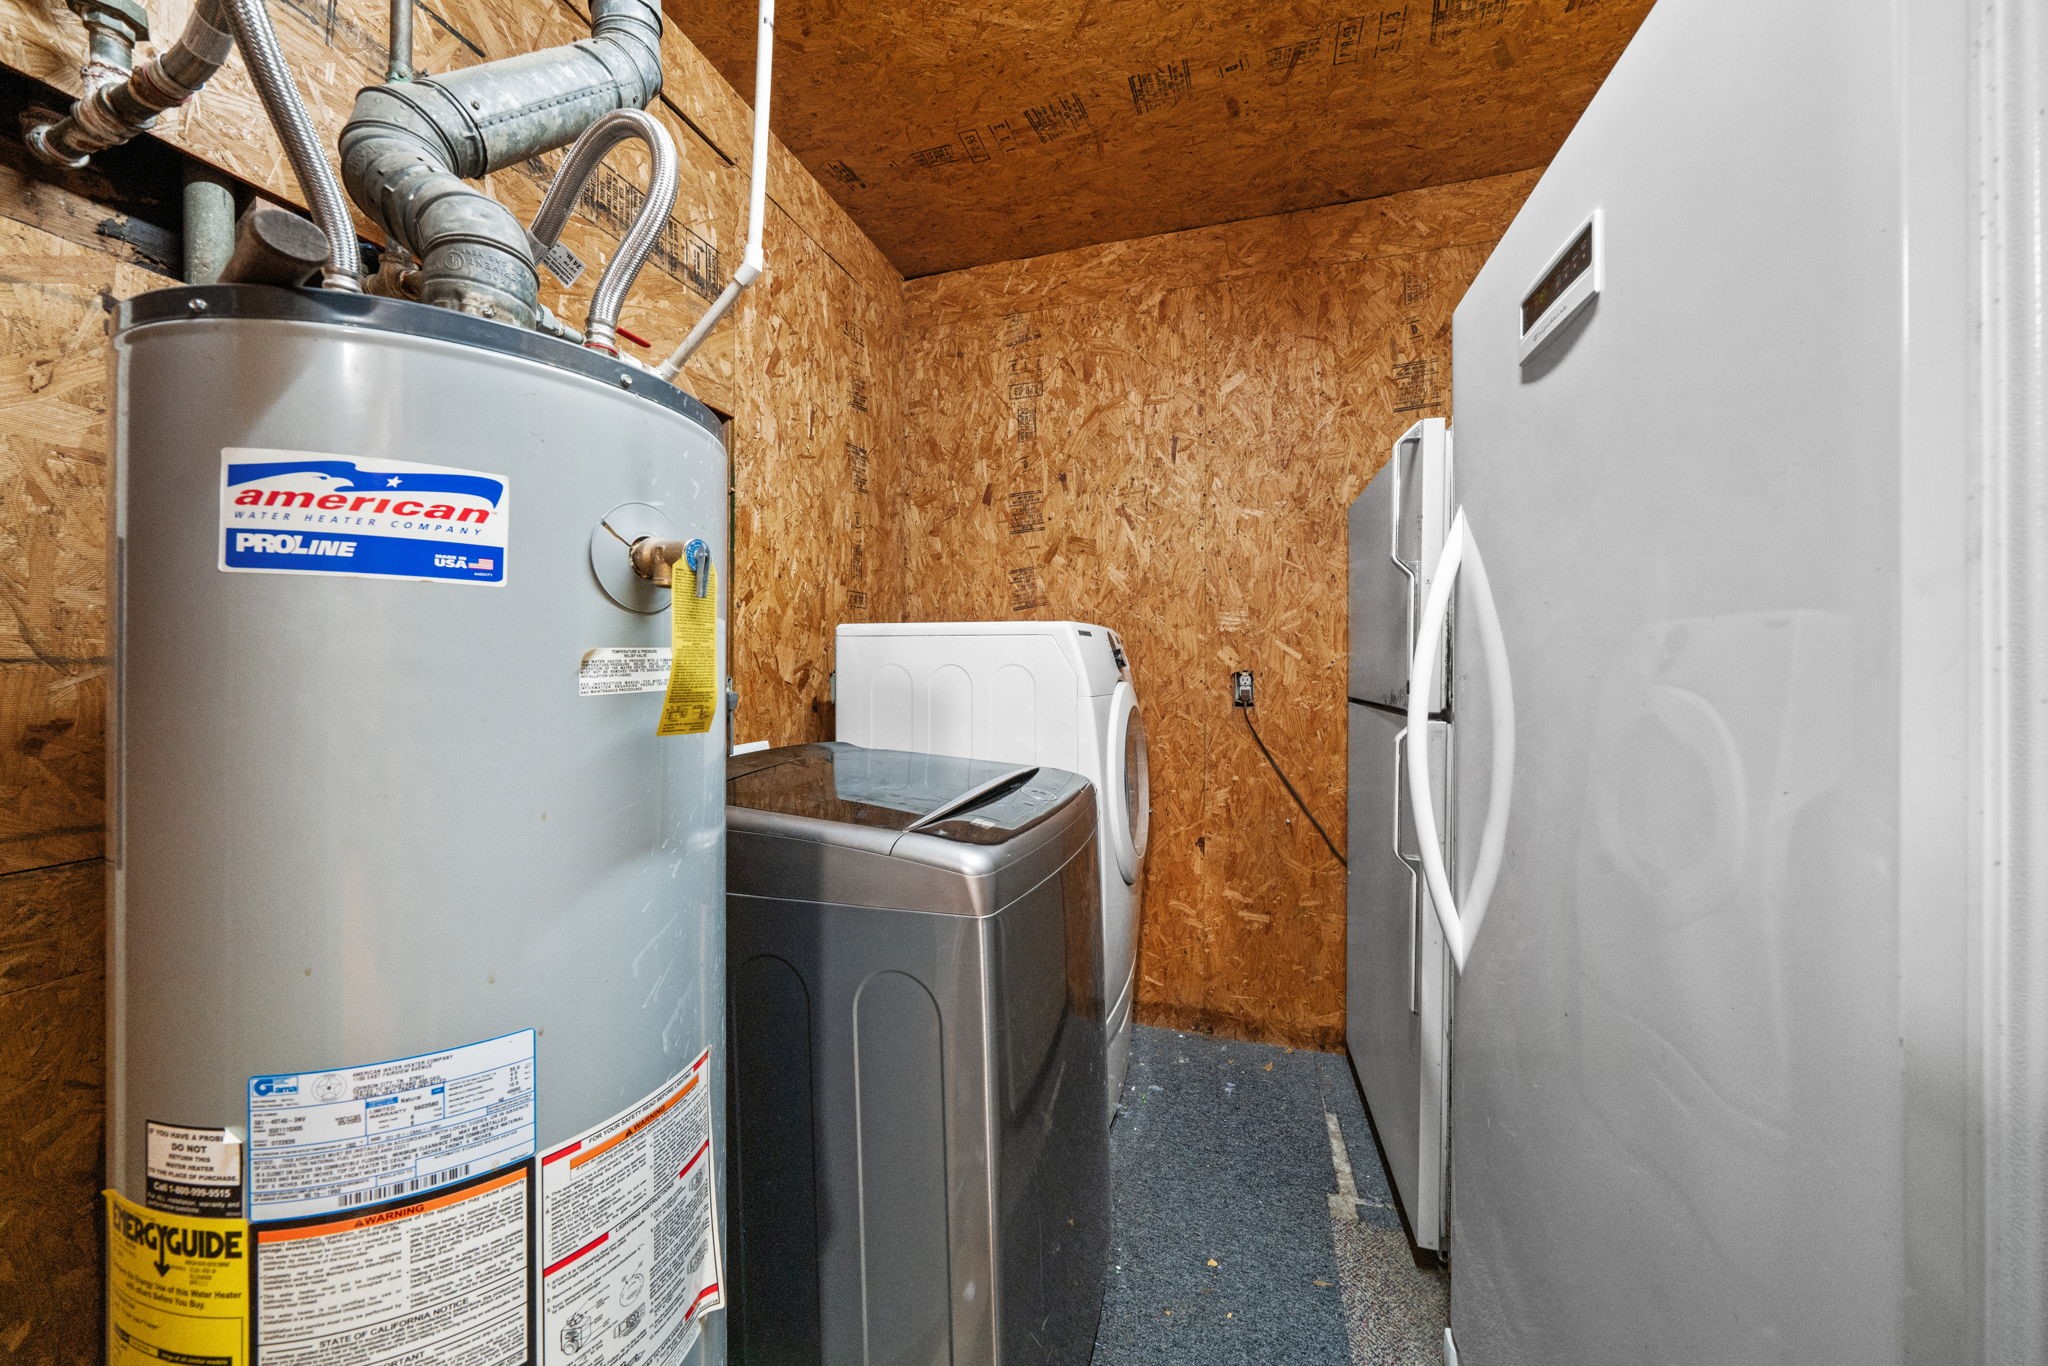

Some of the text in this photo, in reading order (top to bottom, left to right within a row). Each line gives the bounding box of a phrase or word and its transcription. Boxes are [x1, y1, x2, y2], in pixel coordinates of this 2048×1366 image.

[234, 489, 490, 524] american
[234, 511, 482, 536] WATER HEATER COMPANY
[434, 558, 468, 569] USA
[588, 1134, 603, 1144] FOR
[604, 1125, 621, 1136] YOUR
[621, 1110, 642, 1126] SAFETY
[642, 1101, 657, 1113] READ
[656, 1087, 675, 1103] BEFORE
[632, 1105, 666, 1131] WARNING
[170, 1132, 190, 1140] HAVE
[171, 1143, 207, 1153] DO NOT
[166, 1162, 186, 1170] WATER
[168, 1171, 187, 1179] PLACE
[154, 1181, 168, 1191] Call
[364, 1204, 424, 1225] WARNING
[616, 1211, 641, 1233] LIGHTING
[191, 1290, 212, 1299] Water
[215, 1291, 242, 1299] Heater
[320, 1297, 470, 1348] STATE OF CALIFORNIA NOTICE
